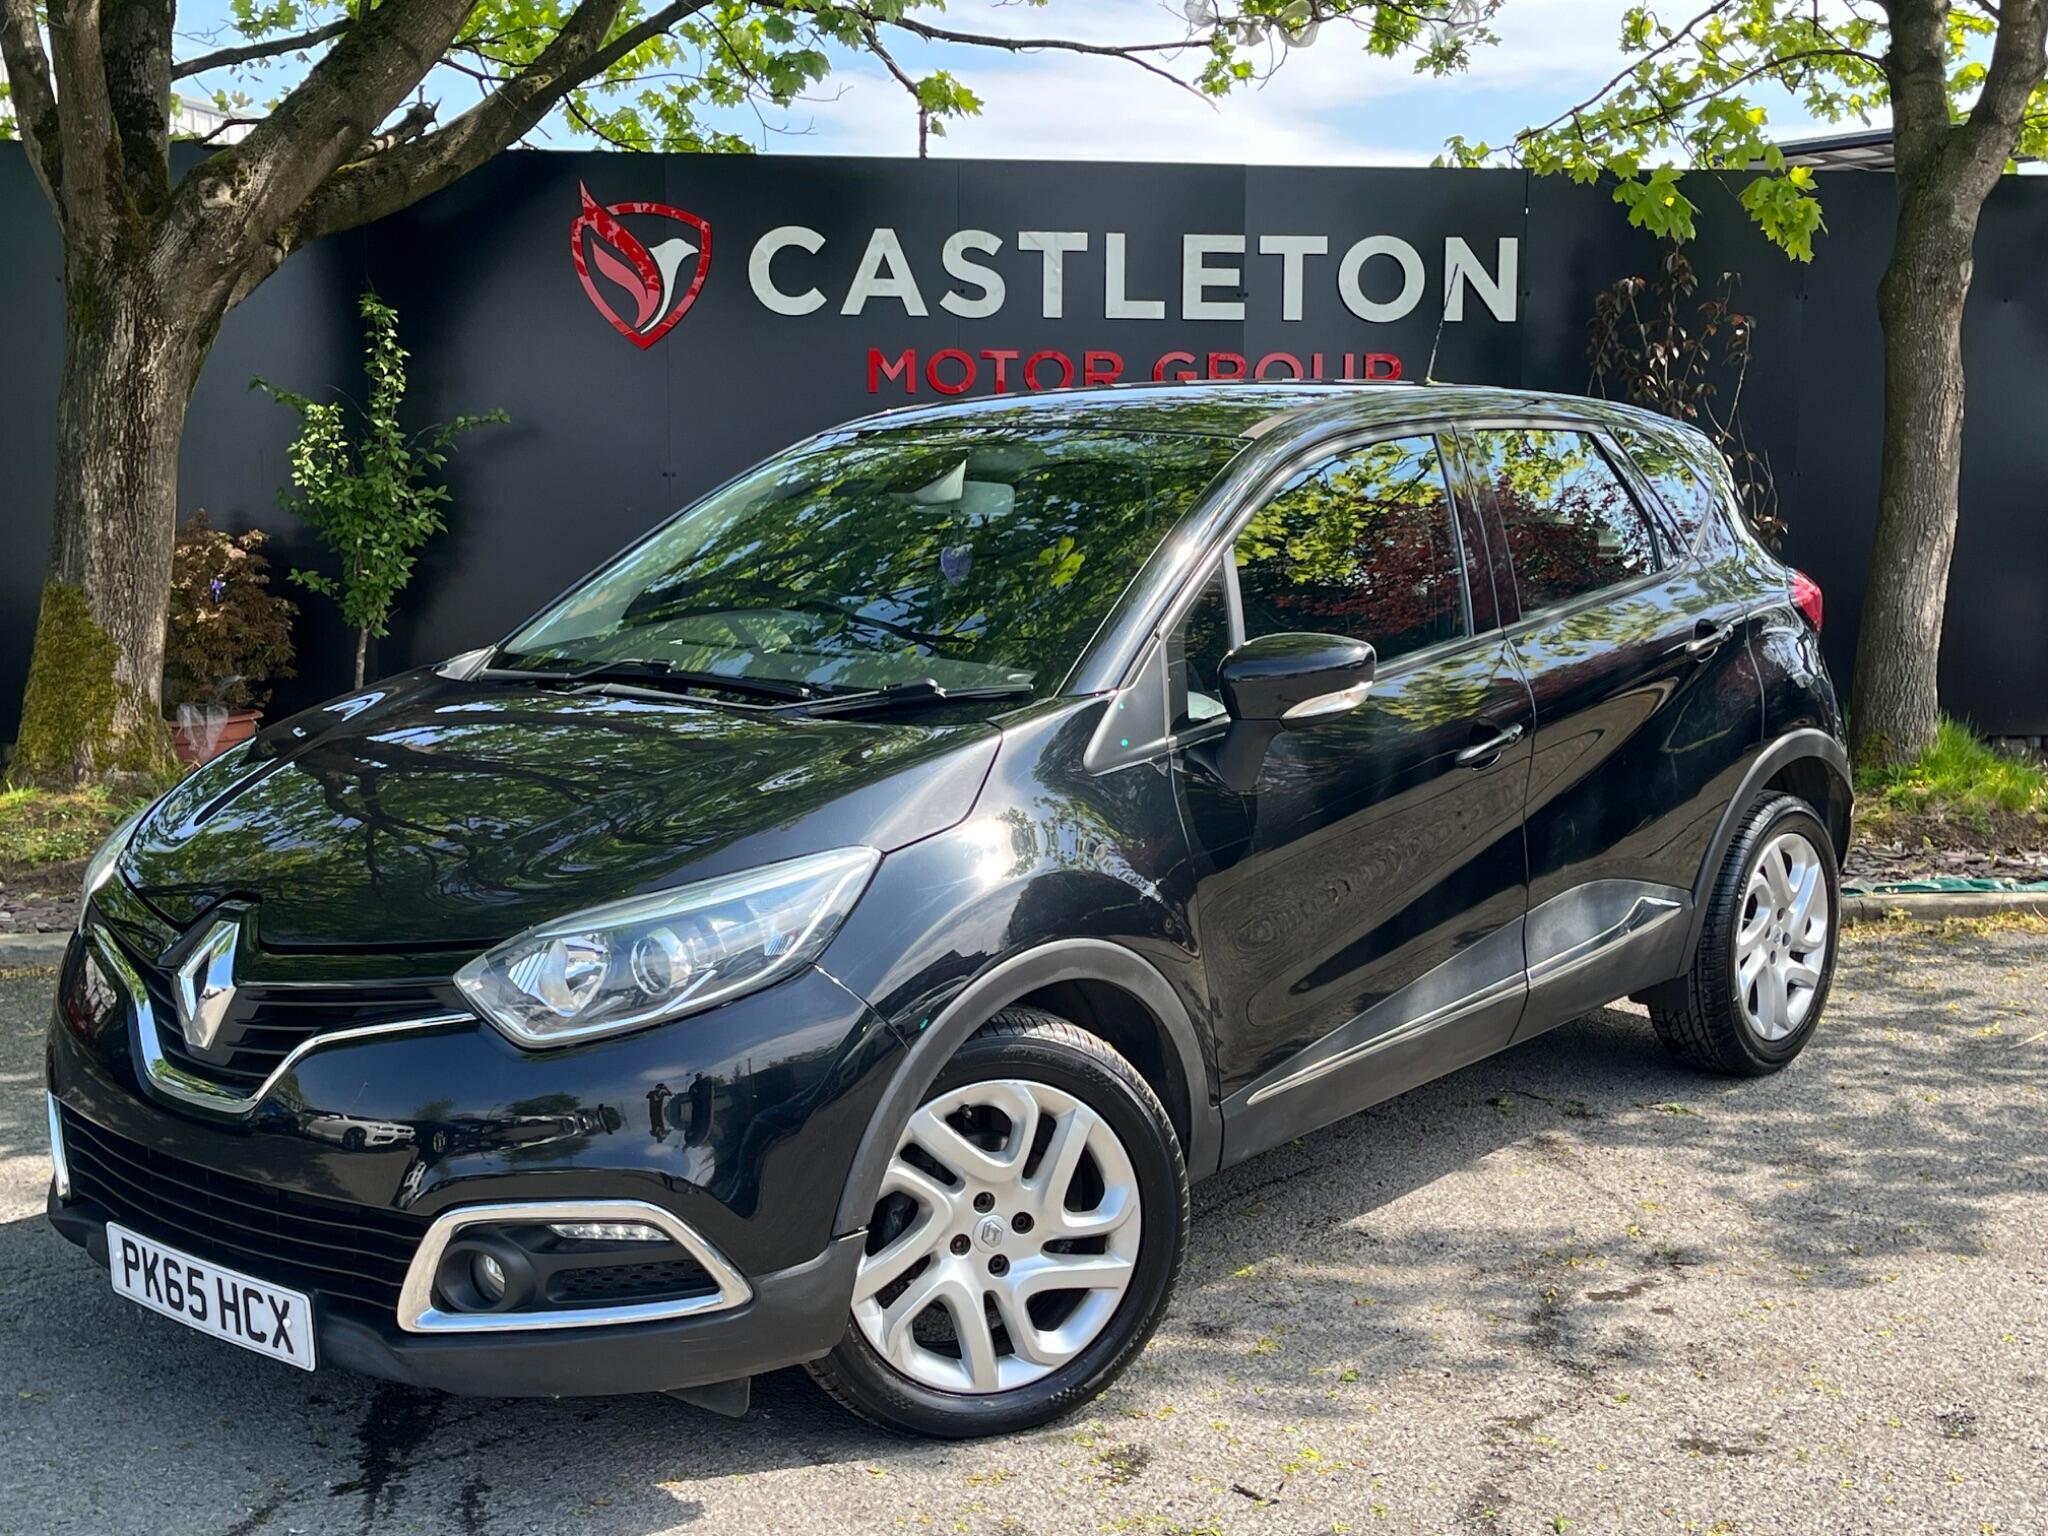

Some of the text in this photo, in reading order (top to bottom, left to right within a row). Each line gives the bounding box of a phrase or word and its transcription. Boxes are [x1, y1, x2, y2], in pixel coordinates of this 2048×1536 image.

[748, 225, 1518, 322] CASTLETON
[867, 347, 1125, 396] MOTOR
[121, 1236, 295, 1355] PK65 HCX
